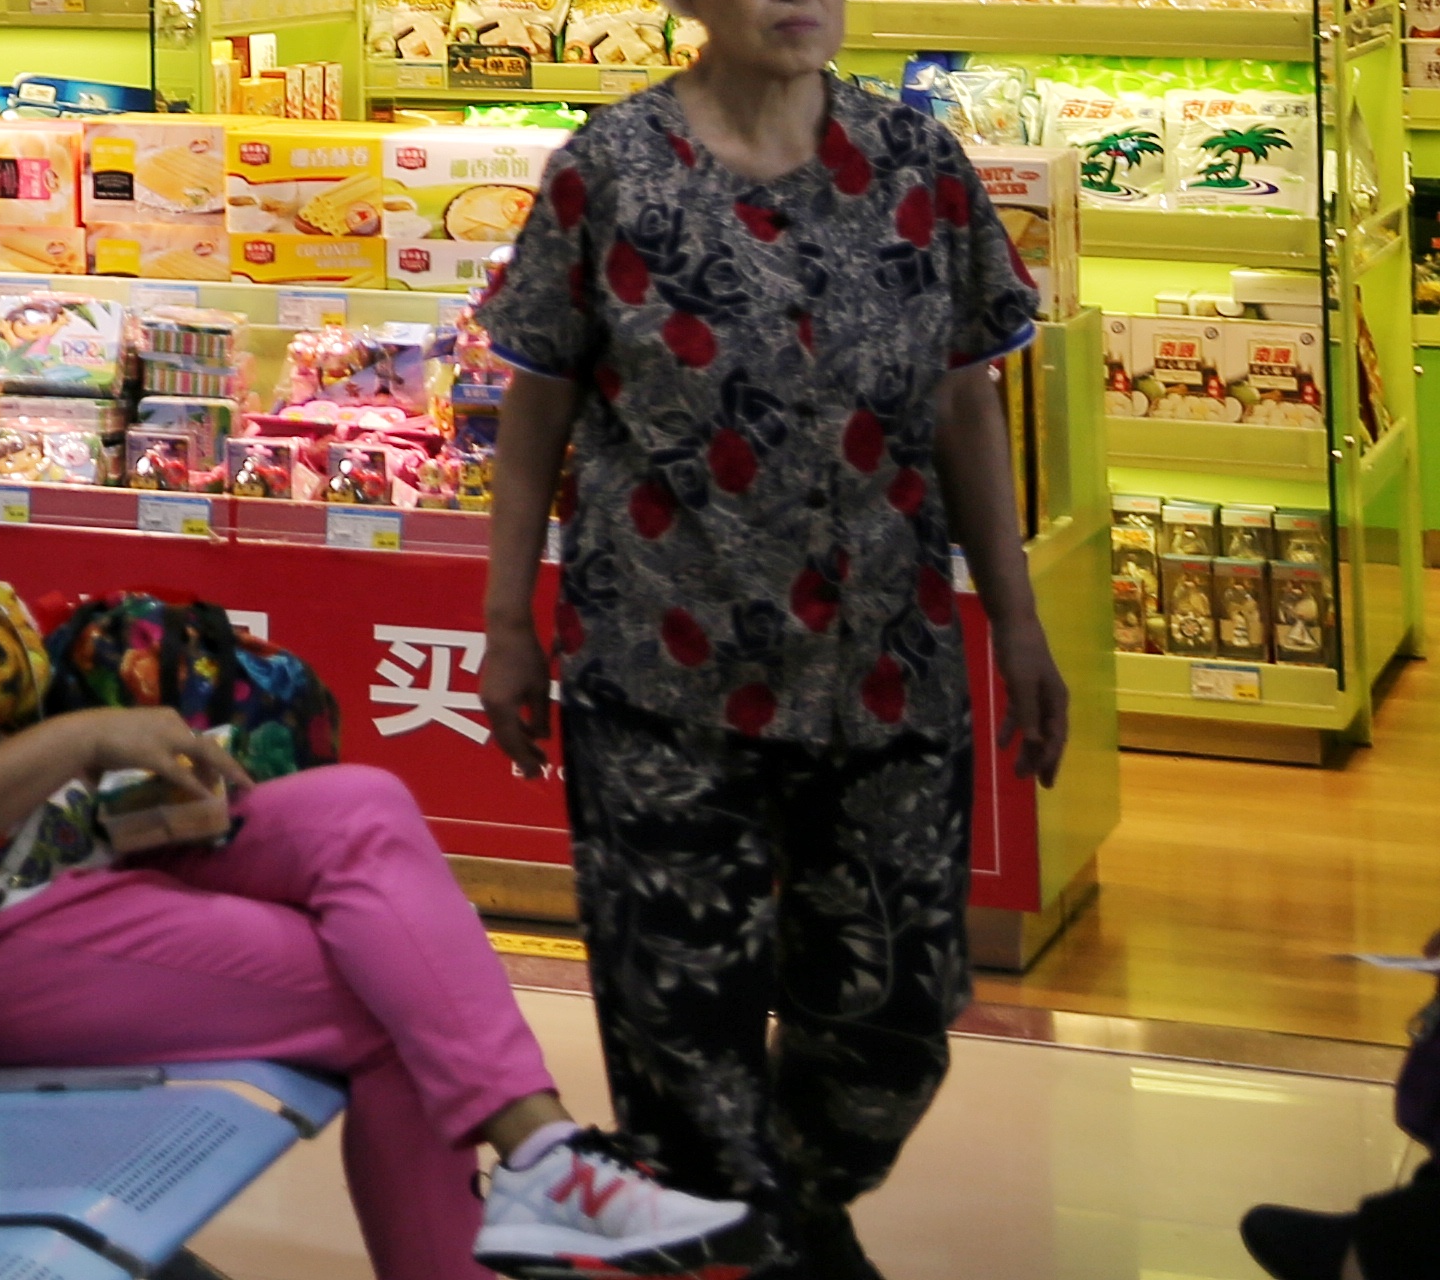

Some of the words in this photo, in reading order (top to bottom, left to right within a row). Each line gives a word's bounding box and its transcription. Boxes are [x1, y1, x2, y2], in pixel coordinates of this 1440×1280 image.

[453, 55, 527, 76] 人气单品
[368, 623, 492, 746] 买
